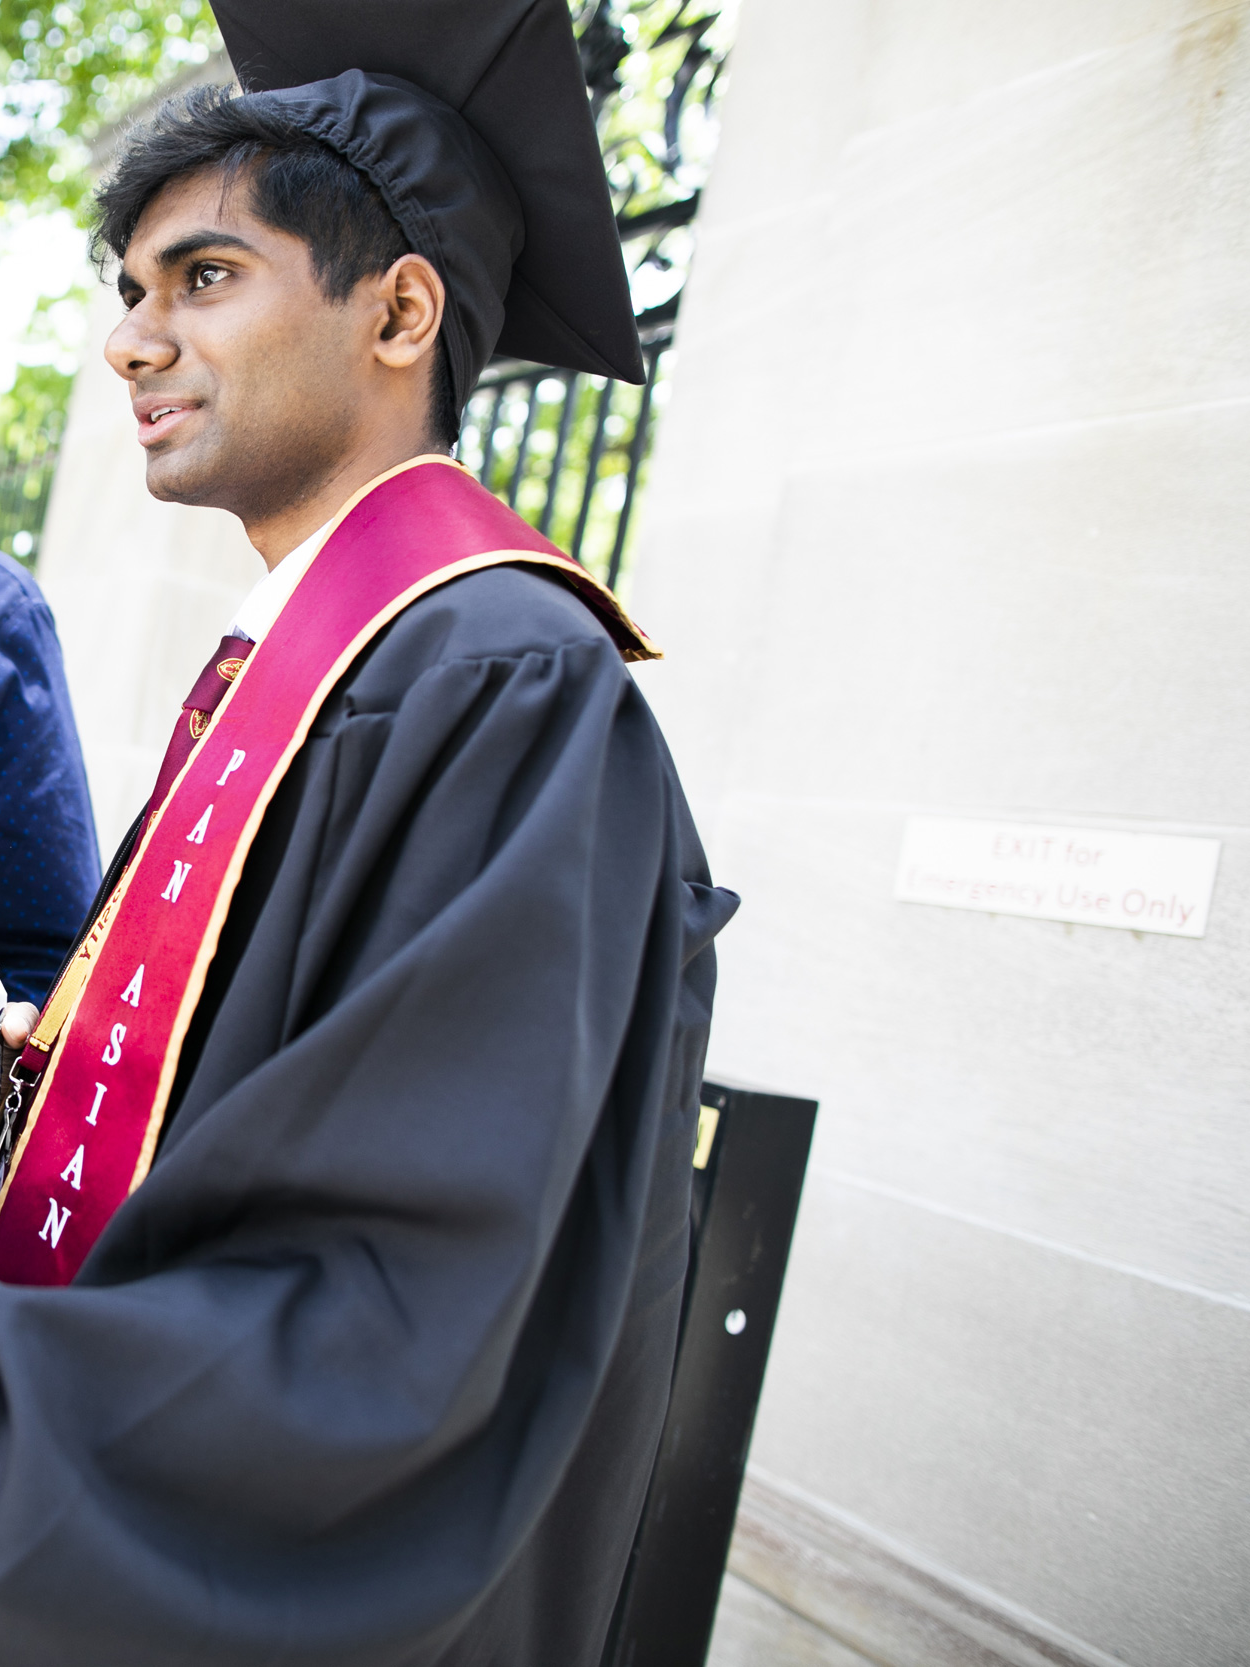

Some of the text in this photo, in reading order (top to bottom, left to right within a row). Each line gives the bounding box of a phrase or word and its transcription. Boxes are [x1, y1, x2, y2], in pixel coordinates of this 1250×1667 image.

[992, 831, 1106, 867] EXIT for
[906, 865, 1198, 928] Emergency Use Only
[38, 748, 246, 1249] PAN ASIAN
